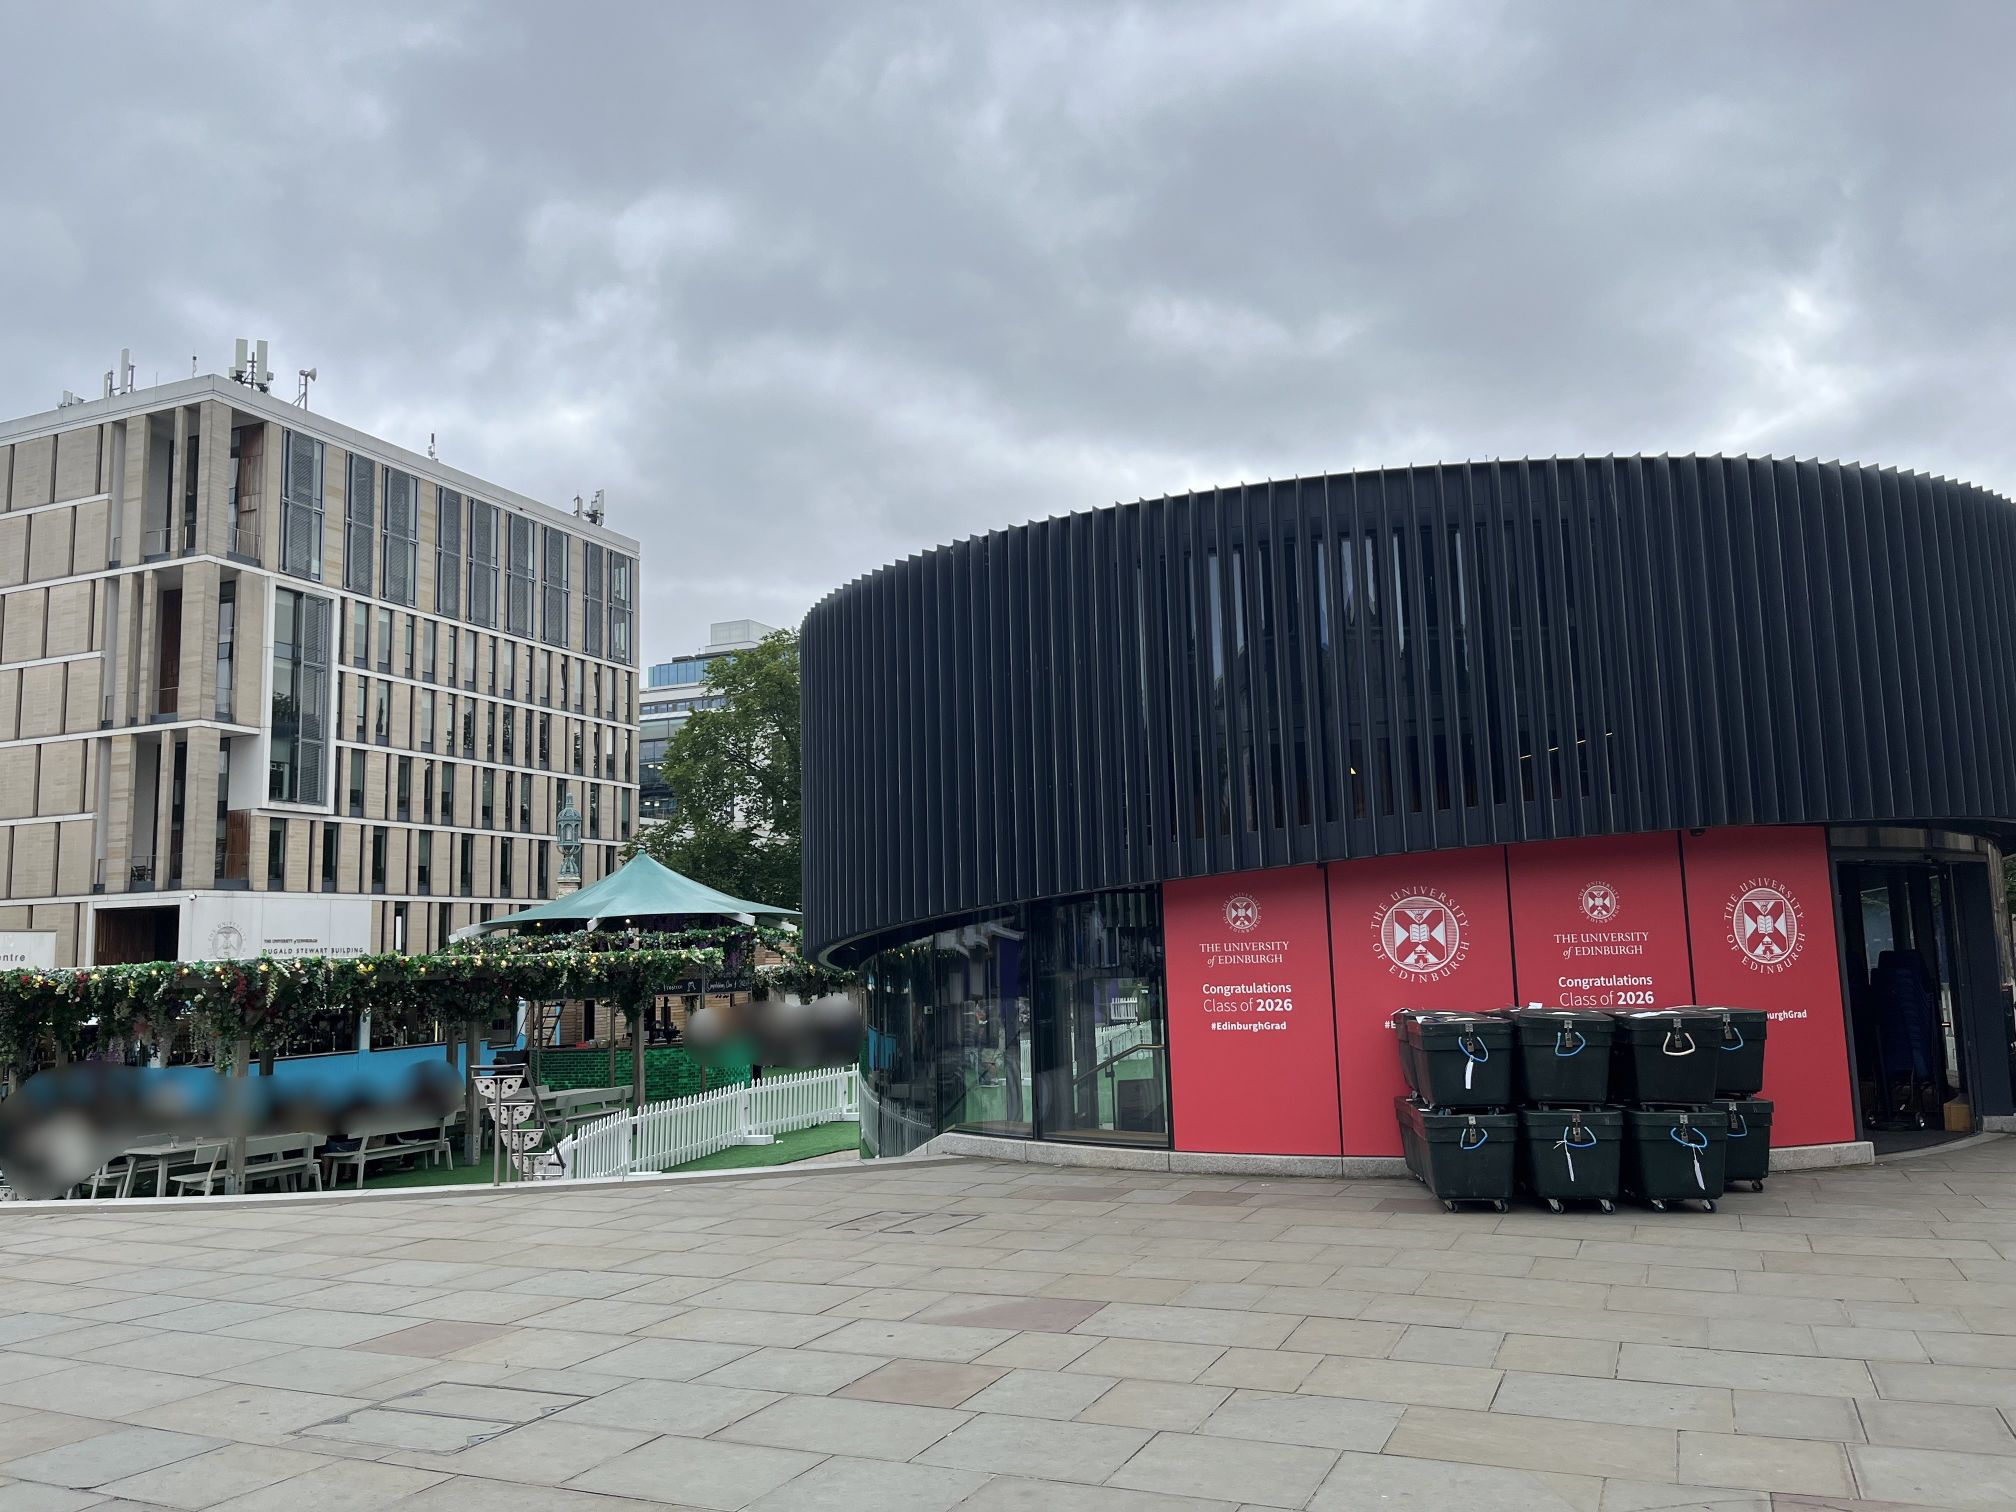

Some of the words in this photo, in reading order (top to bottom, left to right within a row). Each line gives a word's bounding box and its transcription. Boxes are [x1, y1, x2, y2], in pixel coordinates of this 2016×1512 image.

[1724, 894, 1739, 920] THE
[1739, 878, 1804, 919] UNIVERSITY
[1371, 902, 1389, 929] THE
[1390, 886, 1470, 928] UNIVERSITY
[1553, 933, 1578, 944] THE
[1580, 931, 1649, 943] UNIVERSITY
[1199, 943, 1221, 953] THE
[1223, 941, 1290, 952] UNIVERSITY
[1562, 946, 1574, 960] of
[1575, 944, 1643, 956] EDINBURGH
[1726, 934, 1740, 952] OF
[1741, 932, 1806, 974] EDINBURGH
[0, 953, 26, 962] ntre
[1207, 955, 1217, 968] of
[1218, 953, 1283, 965] EDINBURGH
[1372, 943, 1387, 960] OF
[1389, 941, 1470, 983] EDINBURGH
[1202, 982, 1292, 997] Congratulations
[1558, 974, 1653, 990] Congratulations
[1203, 998, 1238, 1013] Class
[1240, 997, 1254, 1012] of
[1256, 998, 1293, 1012] 2026
[1559, 991, 1597, 1007] Class
[1600, 990, 1614, 1006] of
[1616, 991, 1655, 1005] 2026
[1211, 1021, 1287, 1033] #EdinburghGrad
